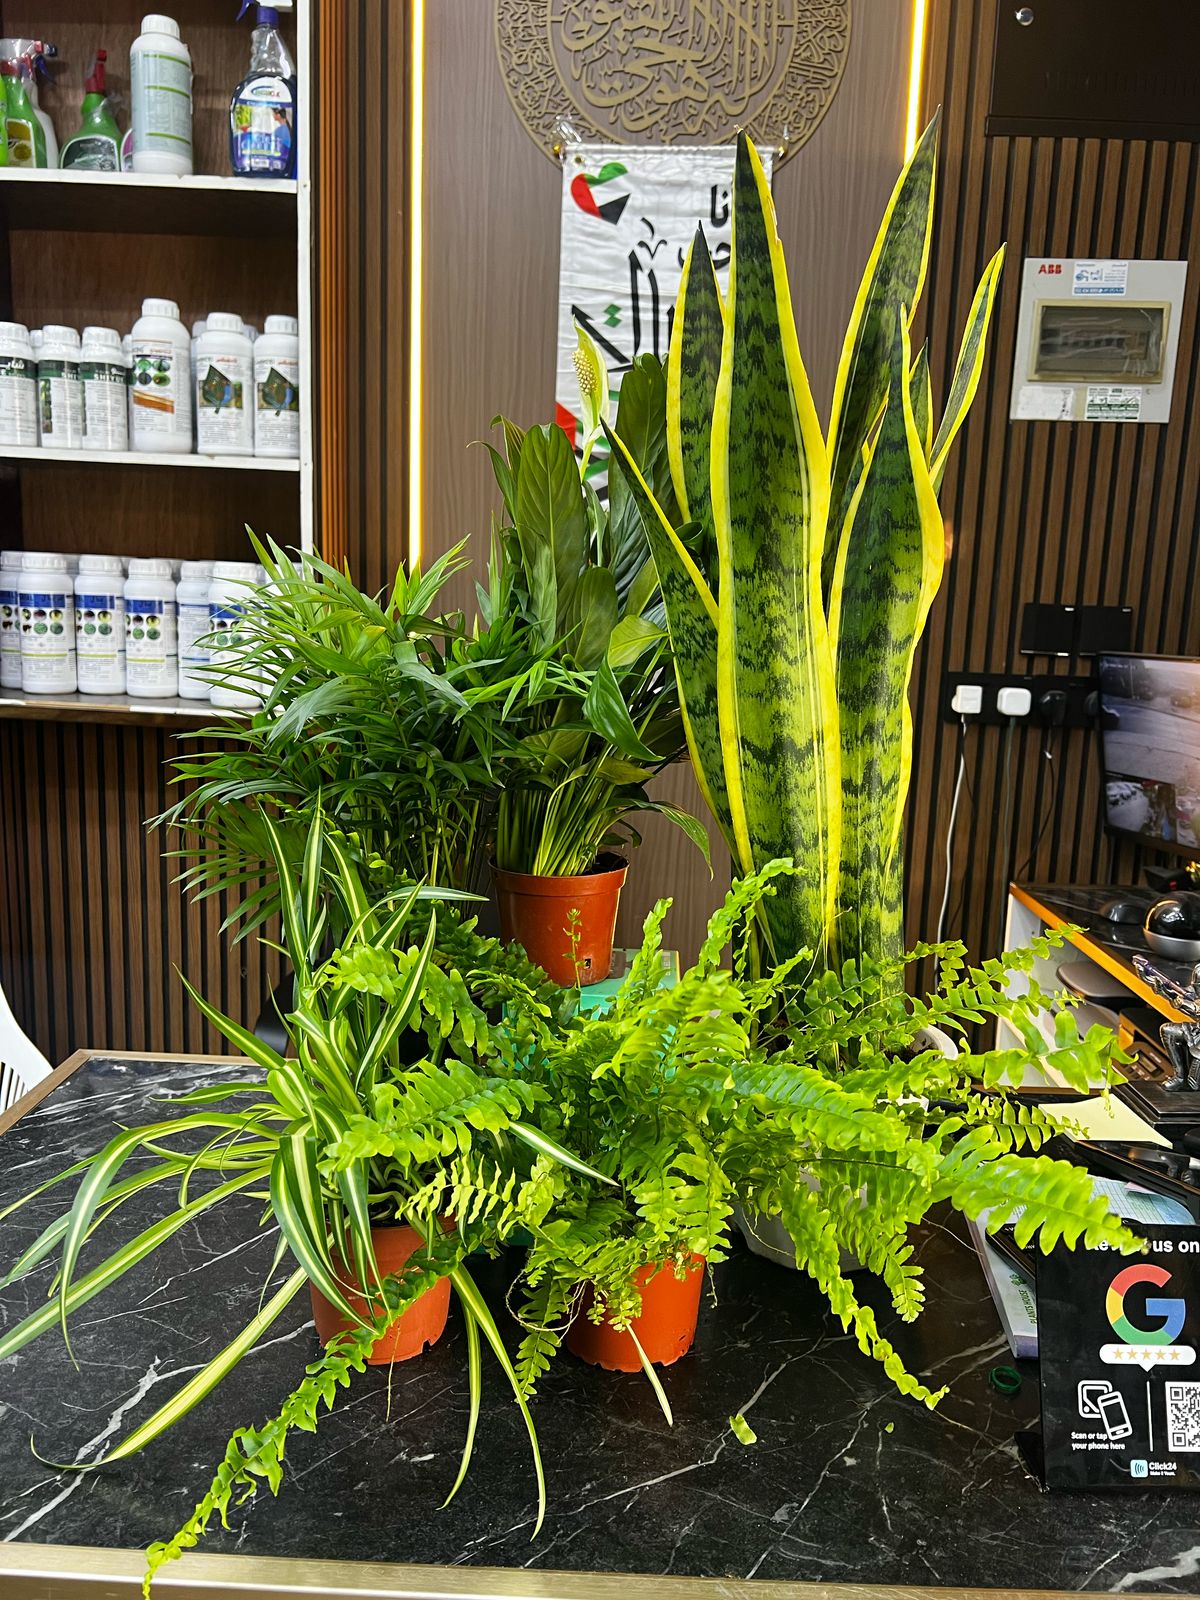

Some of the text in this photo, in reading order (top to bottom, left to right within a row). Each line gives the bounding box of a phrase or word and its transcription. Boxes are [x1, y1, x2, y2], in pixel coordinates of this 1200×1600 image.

[1038, 264, 1062, 274] ABB
[1152, 1240, 1173, 1253] us
[1178, 1240, 1200, 1253] on
[1096, 1432, 1107, 1440] tap
[1088, 1441, 1109, 1451] phone
[1110, 1441, 1125, 1450] here
[1149, 1462, 1177, 1470] Click24
